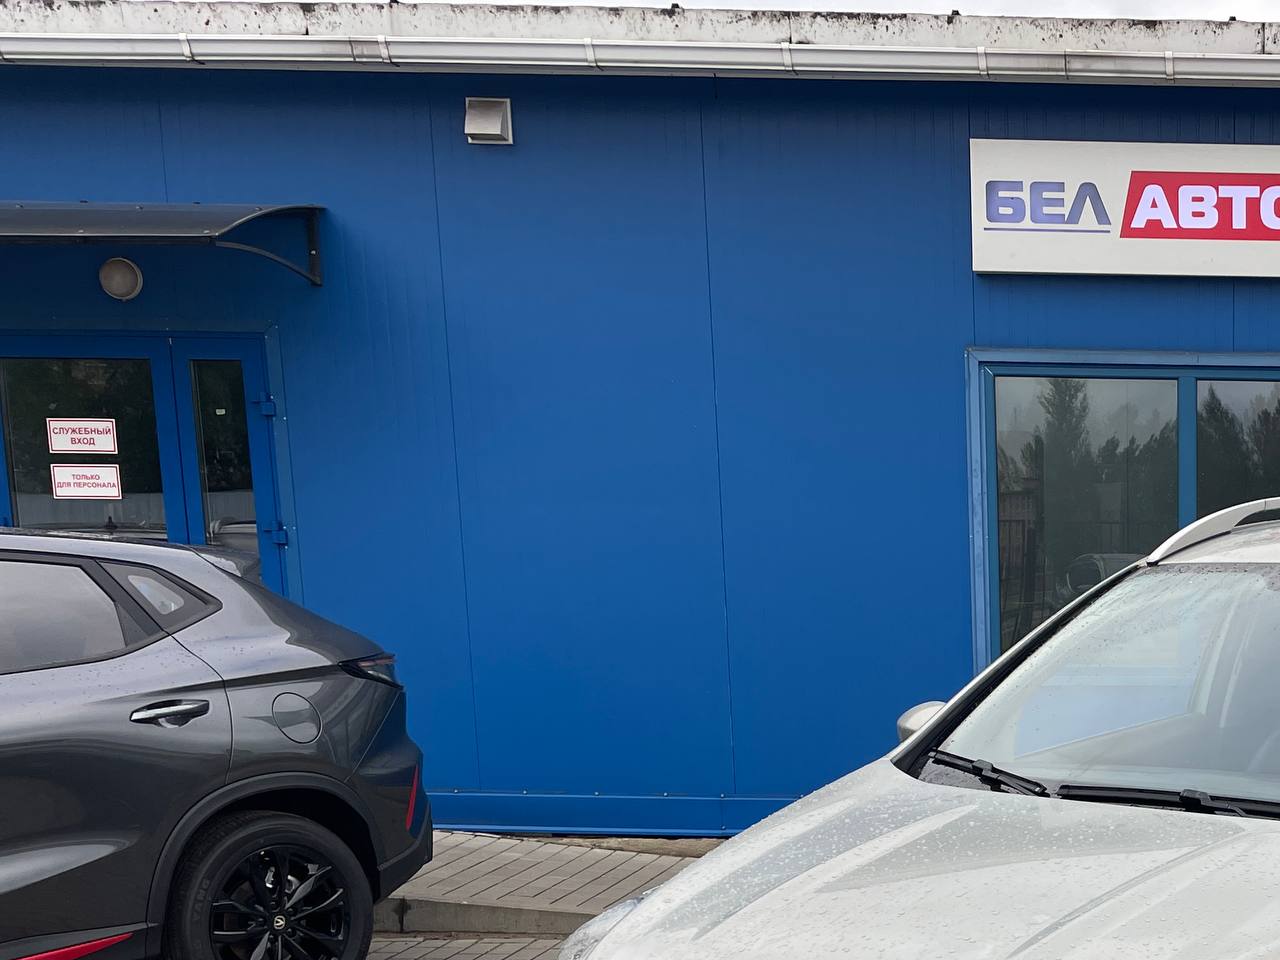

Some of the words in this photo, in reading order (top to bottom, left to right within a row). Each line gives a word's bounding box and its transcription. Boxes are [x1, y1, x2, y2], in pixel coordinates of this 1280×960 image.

[984, 180, 1112, 226] БЕЛ
[52, 426, 112, 435] СЛУЖЕБНЫЙ
[70, 437, 96, 446] ВХОД
[71, 473, 101, 481] ТОЛЬКО
[56, 481, 72, 489] ДЛЯ
[73, 481, 117, 489] ПЕРСОНАЛА
